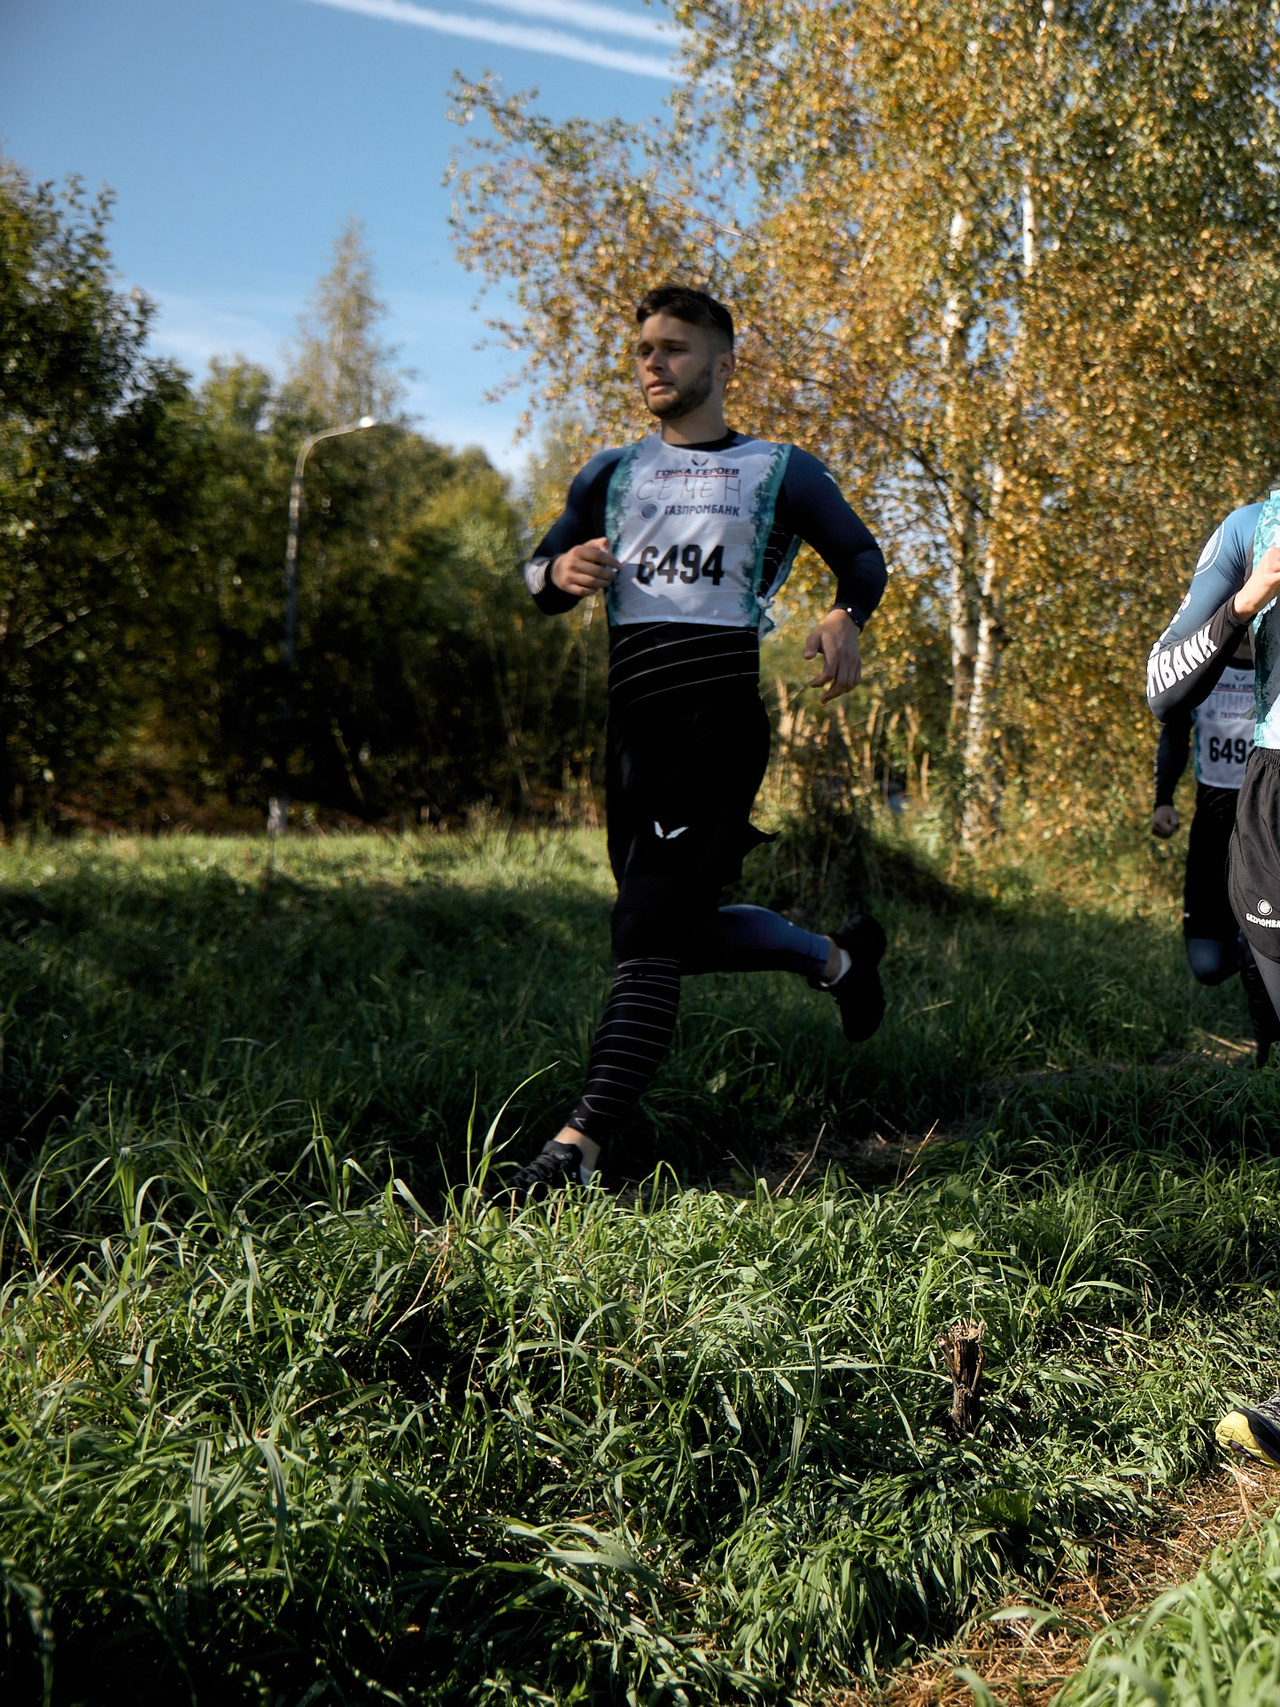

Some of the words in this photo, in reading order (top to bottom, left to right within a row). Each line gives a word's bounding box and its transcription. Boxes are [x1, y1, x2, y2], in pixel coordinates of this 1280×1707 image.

[655, 468, 692, 477] ГОНКА
[696, 467, 740, 476] ГЕРОЕВ
[664, 504, 741, 517] ГАЗПРОМБАНК
[636, 544, 725, 587] 6494
